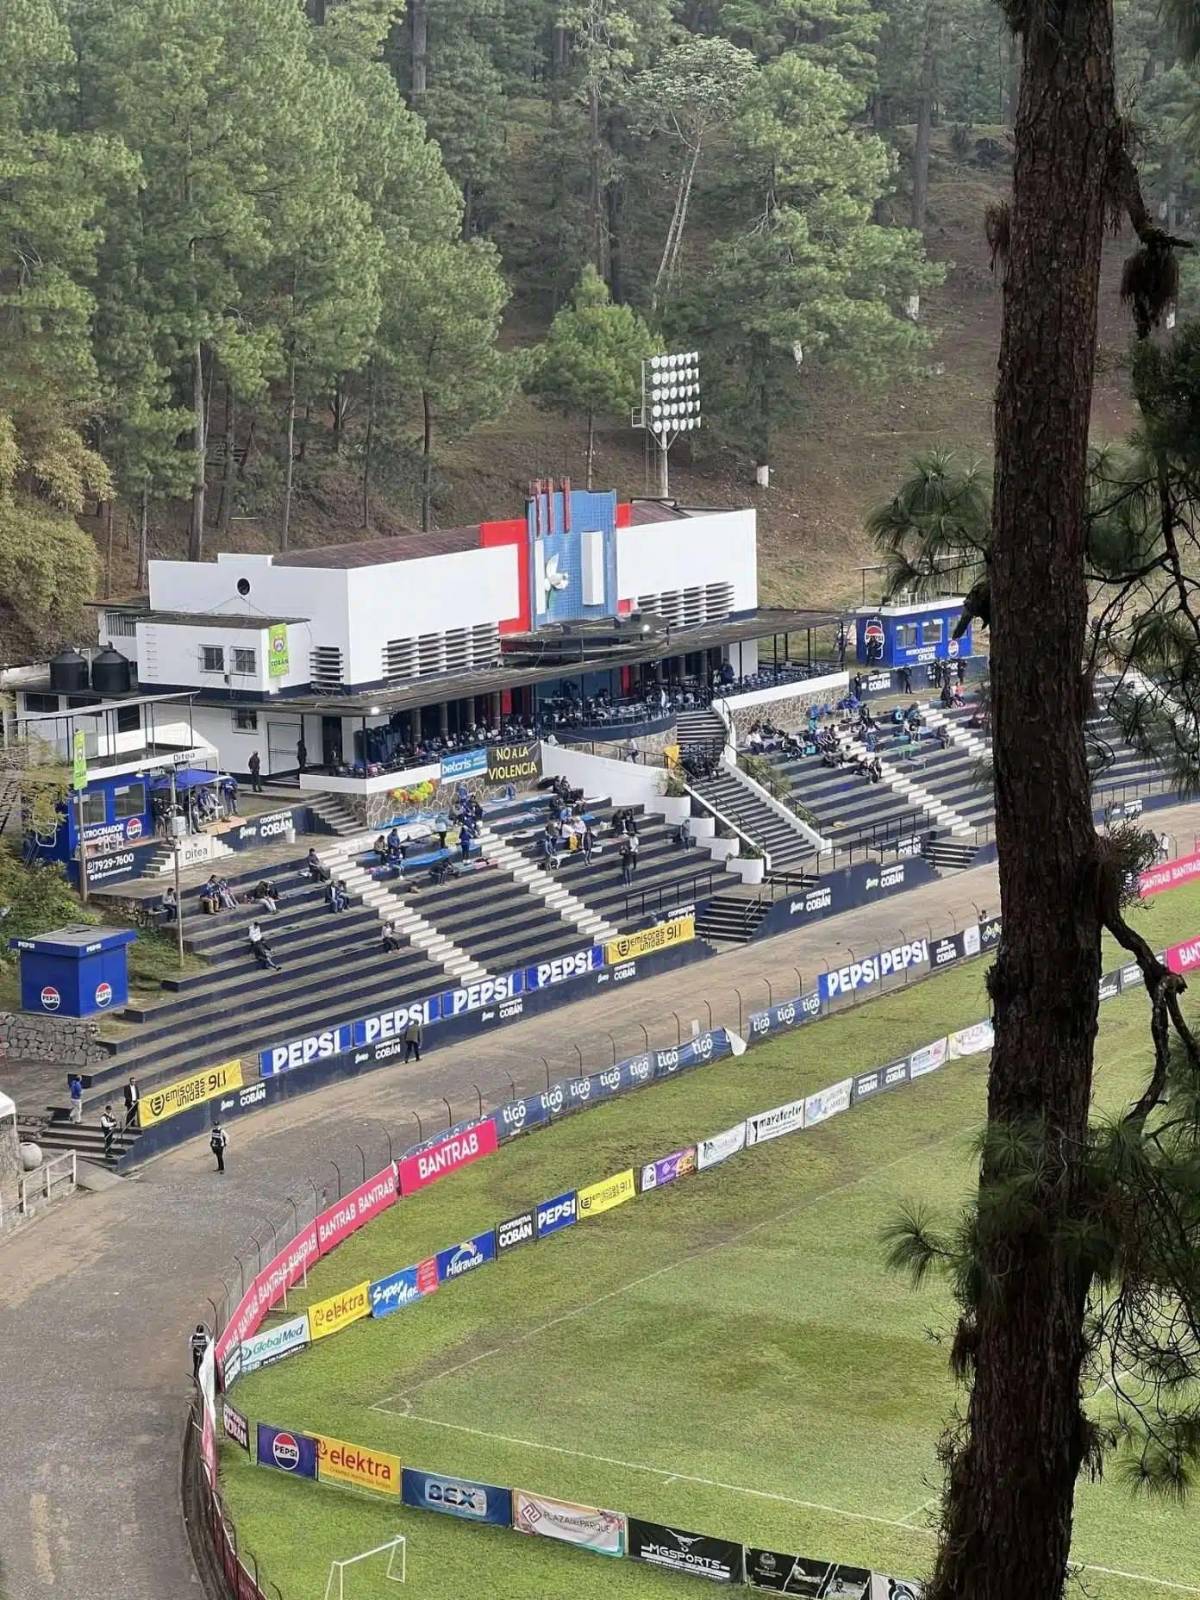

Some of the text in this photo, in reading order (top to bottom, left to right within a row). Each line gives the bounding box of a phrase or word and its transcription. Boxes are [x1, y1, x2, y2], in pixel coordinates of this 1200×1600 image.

[442, 758, 472, 774] betcris
[496, 747, 529, 761] NO A LA
[489, 762, 537, 780] VIOLENCIA
[538, 950, 594, 987] PEPSI
[881, 939, 928, 976] PEPSI
[827, 957, 880, 997] PEPSI
[453, 974, 514, 1015] PEPSI
[365, 1000, 430, 1043] PEPSI
[272, 1029, 341, 1074] PEPSI
[165, 1076, 206, 1102] emisoras
[177, 1088, 206, 1108] unidas
[418, 1133, 479, 1179] BANTRAB
[358, 1177, 395, 1214] BANTRAB
[319, 1204, 357, 1243] BANTRAB
[538, 1198, 576, 1229] PEPSI
[325, 1293, 365, 1323] elektra
[274, 1444, 298, 1458] PEPSI
[330, 1447, 391, 1480] elektra
[649, 1542, 722, 1570] MGSPORTS
